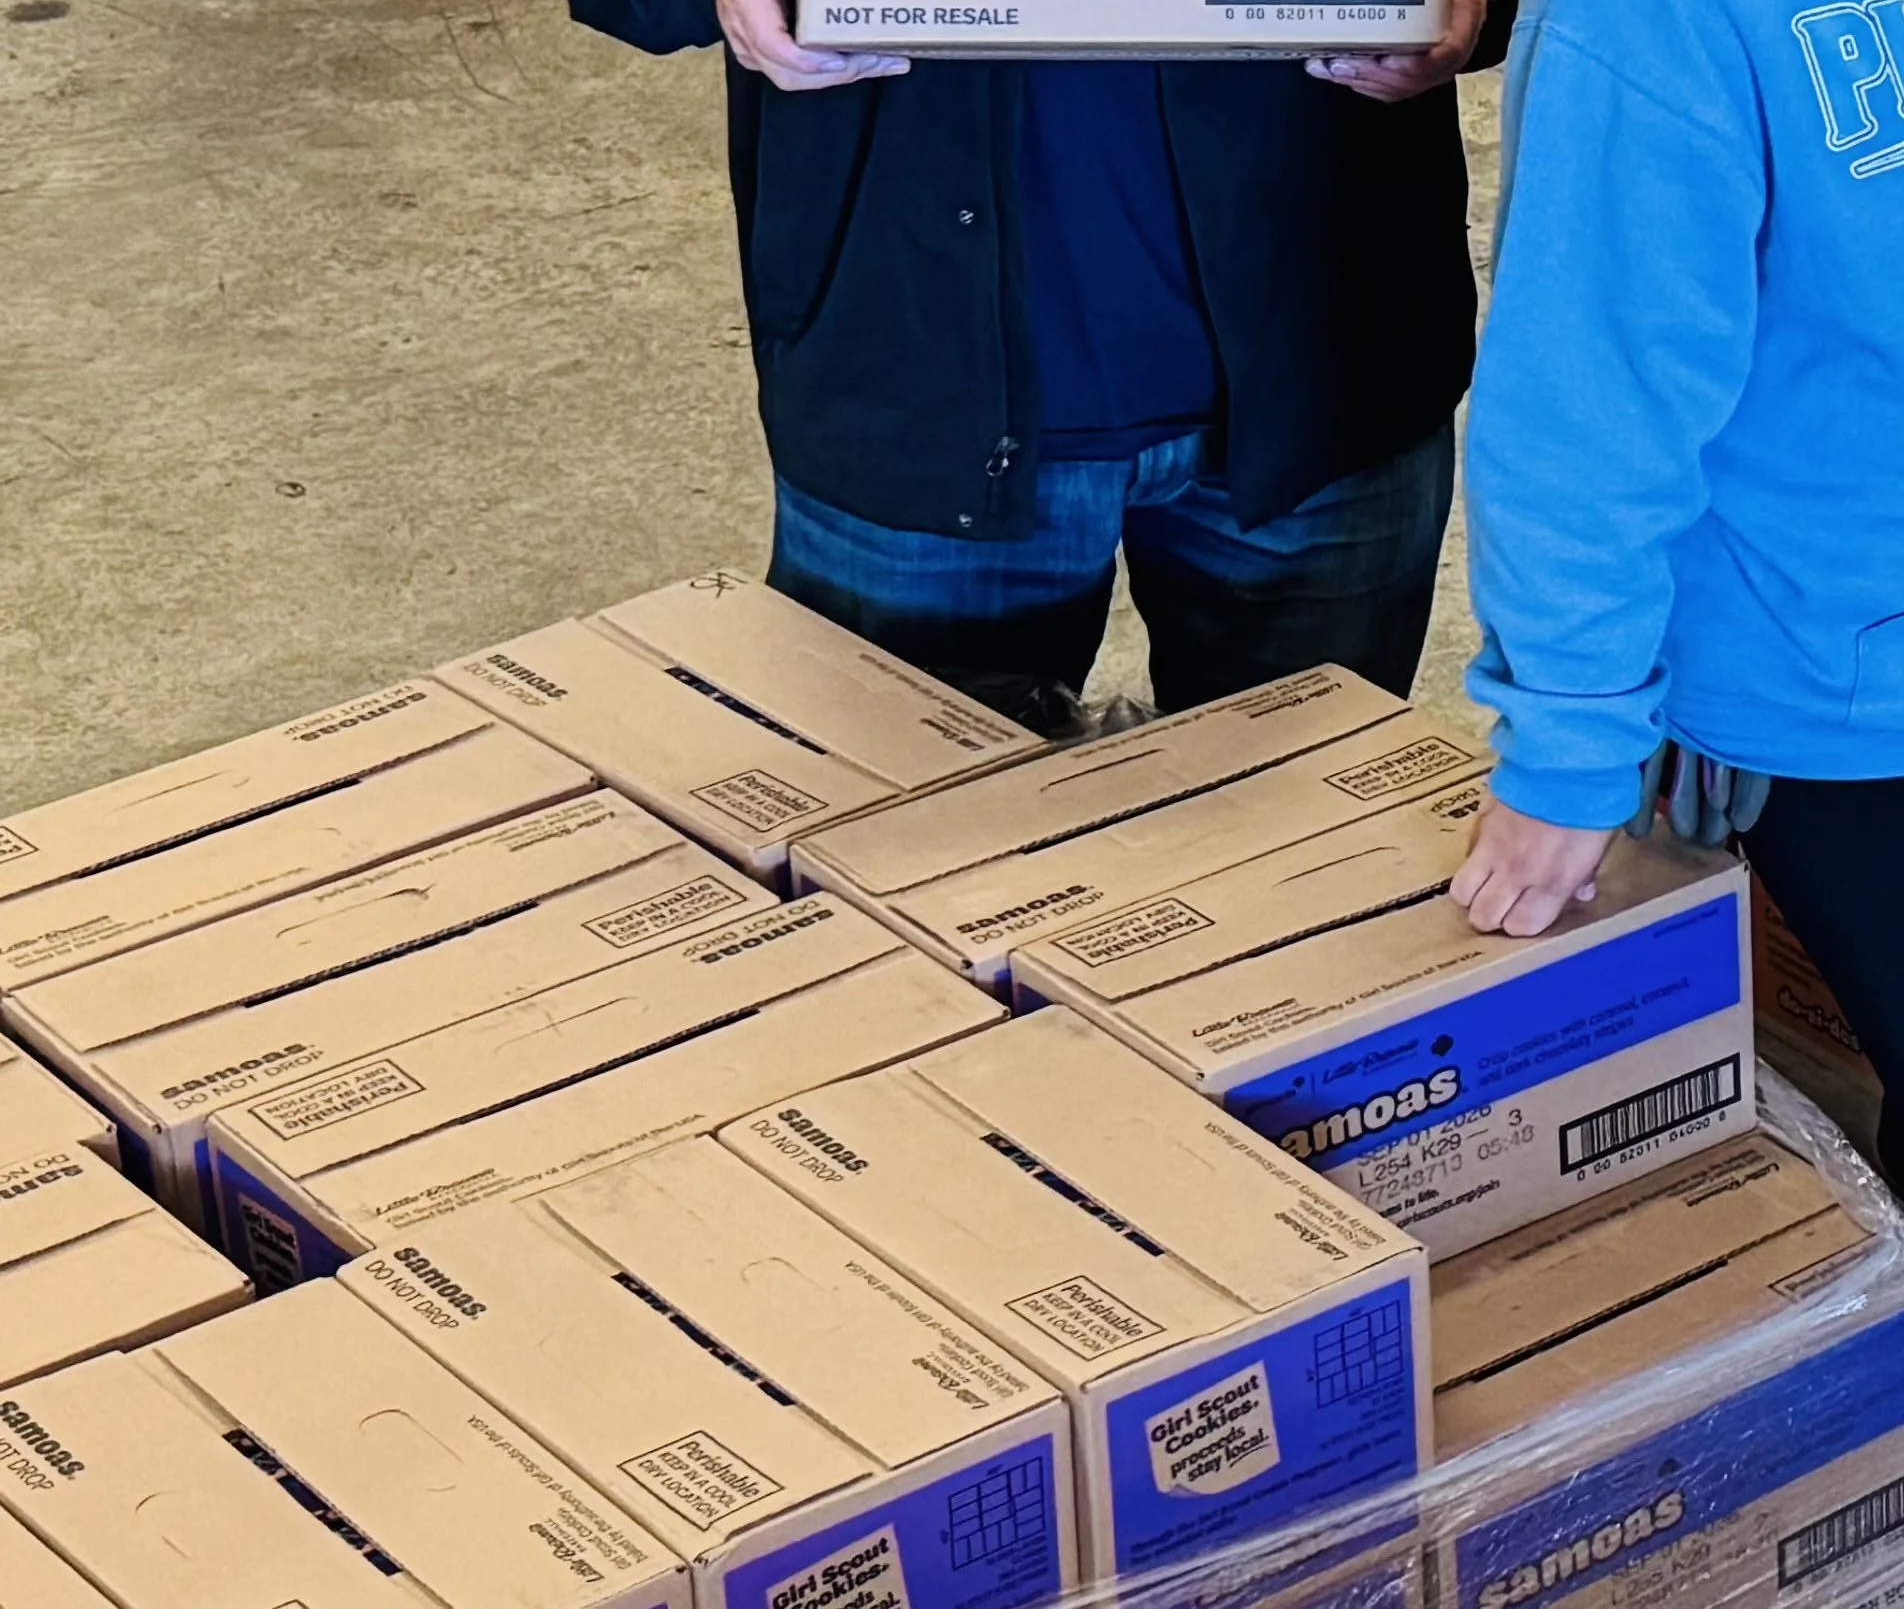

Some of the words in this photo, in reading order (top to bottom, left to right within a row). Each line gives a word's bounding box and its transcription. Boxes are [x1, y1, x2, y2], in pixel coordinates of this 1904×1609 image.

[825, 7, 874, 25] NOT
[881, 7, 927, 25] FOR
[933, 7, 1019, 25] RESALE
[1225, 8, 1235, 20] 0
[1246, 8, 1265, 20] 00
[1276, 8, 1325, 20] 82011
[1337, 8, 1387, 21] 04000
[778, 1107, 868, 1174] samoas
[1280, 1065, 1463, 1159] amoas
[749, 1119, 781, 1139] DO
[773, 1135, 808, 1166] NOT
[799, 1153, 845, 1185] DROP
[394, 1245, 486, 1320] samoas
[1150, 1408, 1193, 1444] Girl
[1197, 1374, 1260, 1421] Scout
[1165, 1399, 1261, 1455] Cookies.
[677, 1440, 761, 1498] Perishable
[1169, 1424, 1247, 1479] proceeds
[1187, 1457, 1222, 1483] stay
[1225, 1427, 1270, 1460] local.
[1477, 1488, 1685, 1609] samoas
